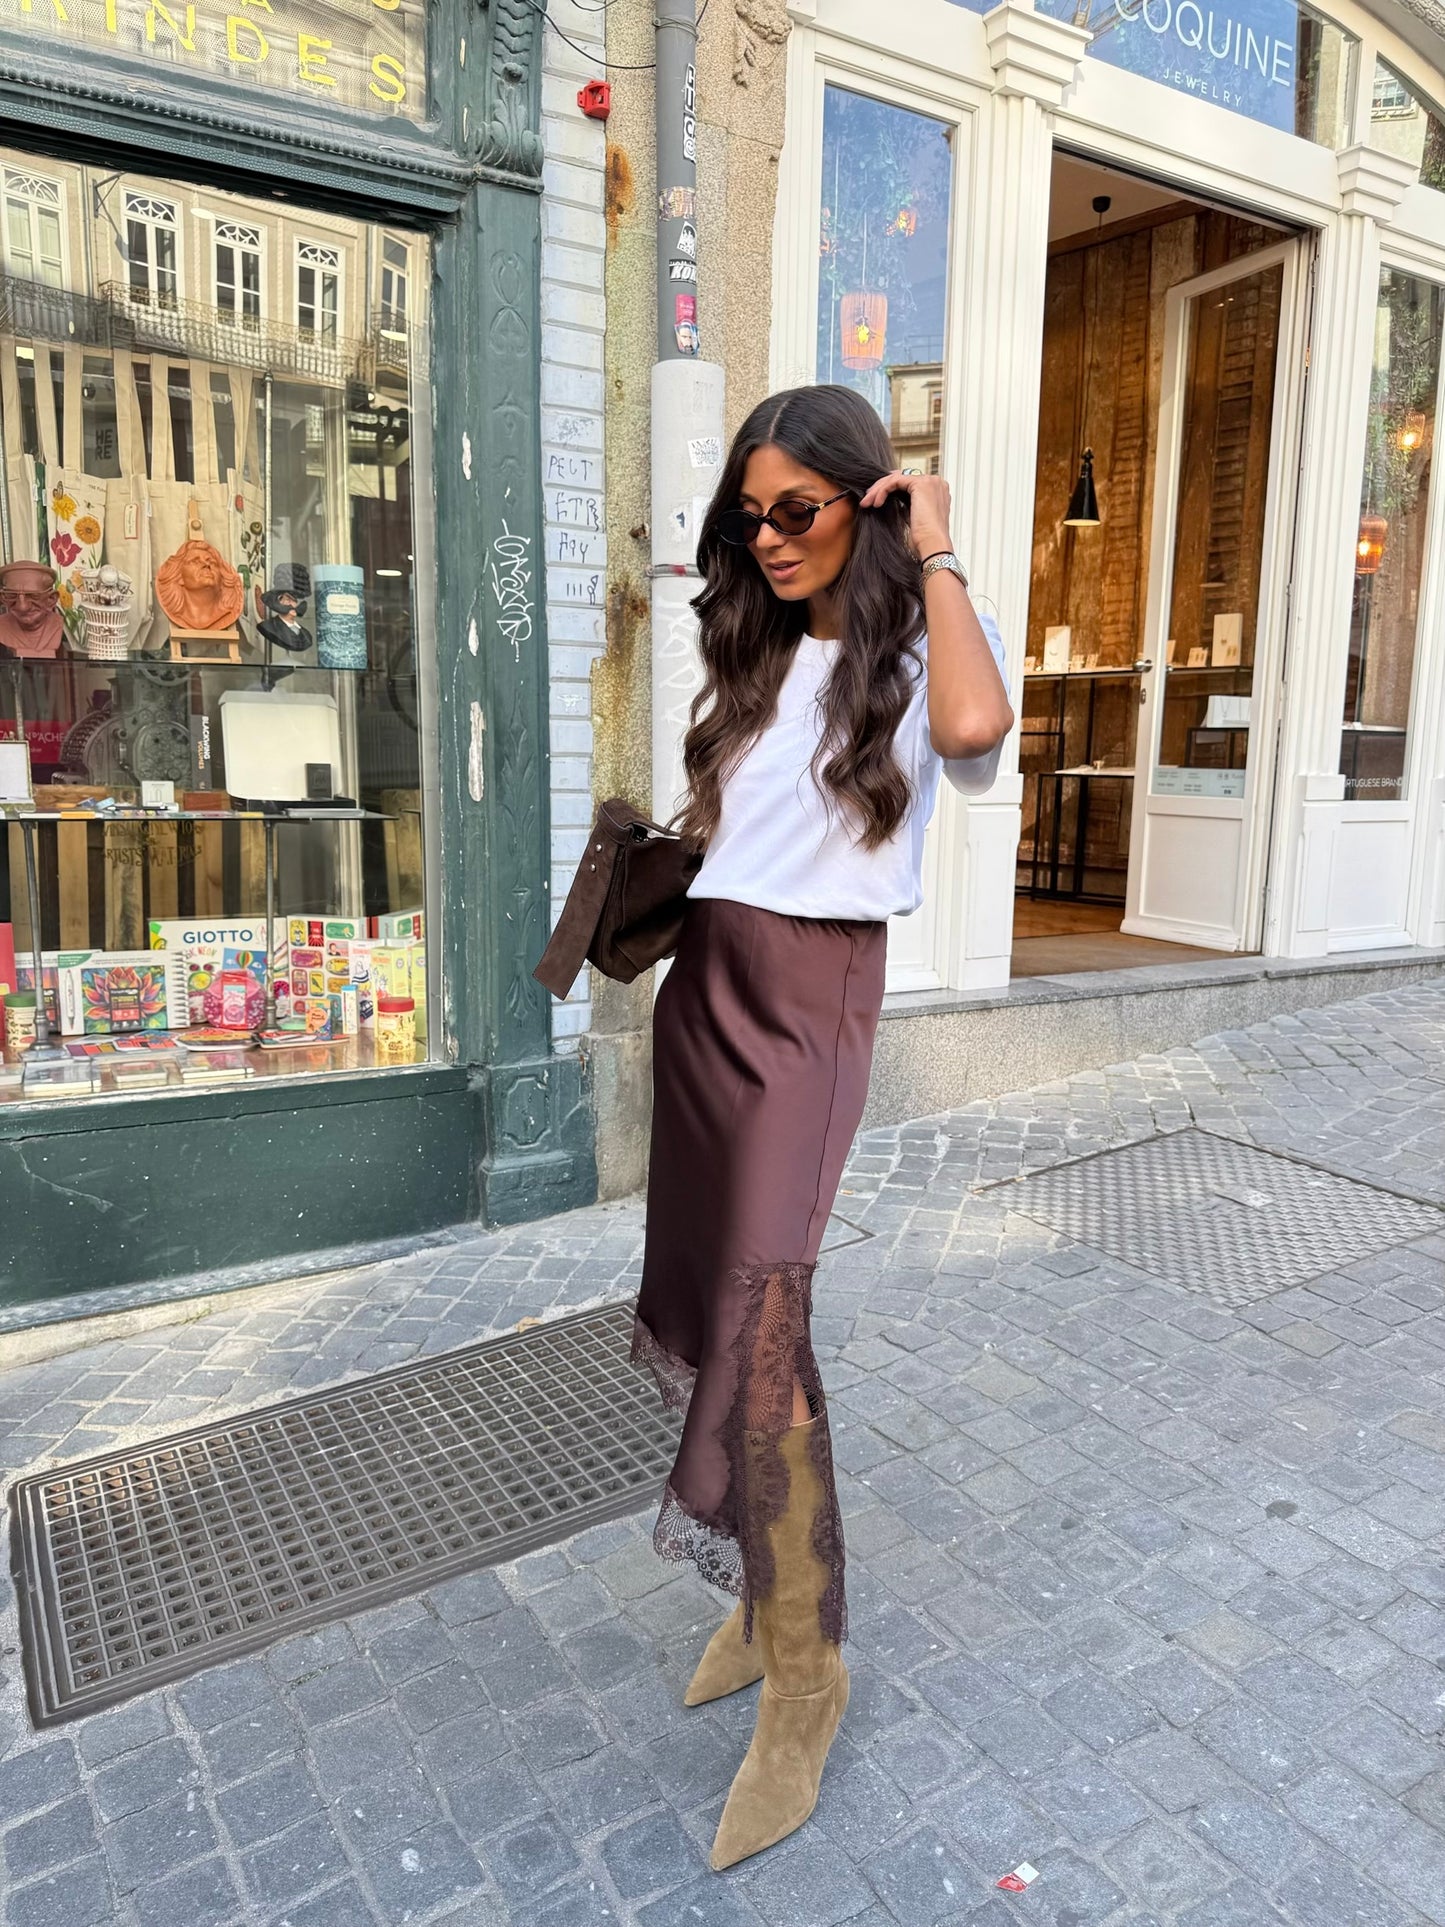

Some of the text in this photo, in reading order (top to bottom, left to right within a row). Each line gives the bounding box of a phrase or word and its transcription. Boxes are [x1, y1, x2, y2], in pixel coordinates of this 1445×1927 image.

[1163, 69, 1242, 106] JEWELRY
[202, 715, 211, 760] BLACKWING
[197, 741, 205, 770] VOLUMES
[1345, 777, 1380, 788] RTUGUESE
[183, 929, 253, 944] GIOTTO
